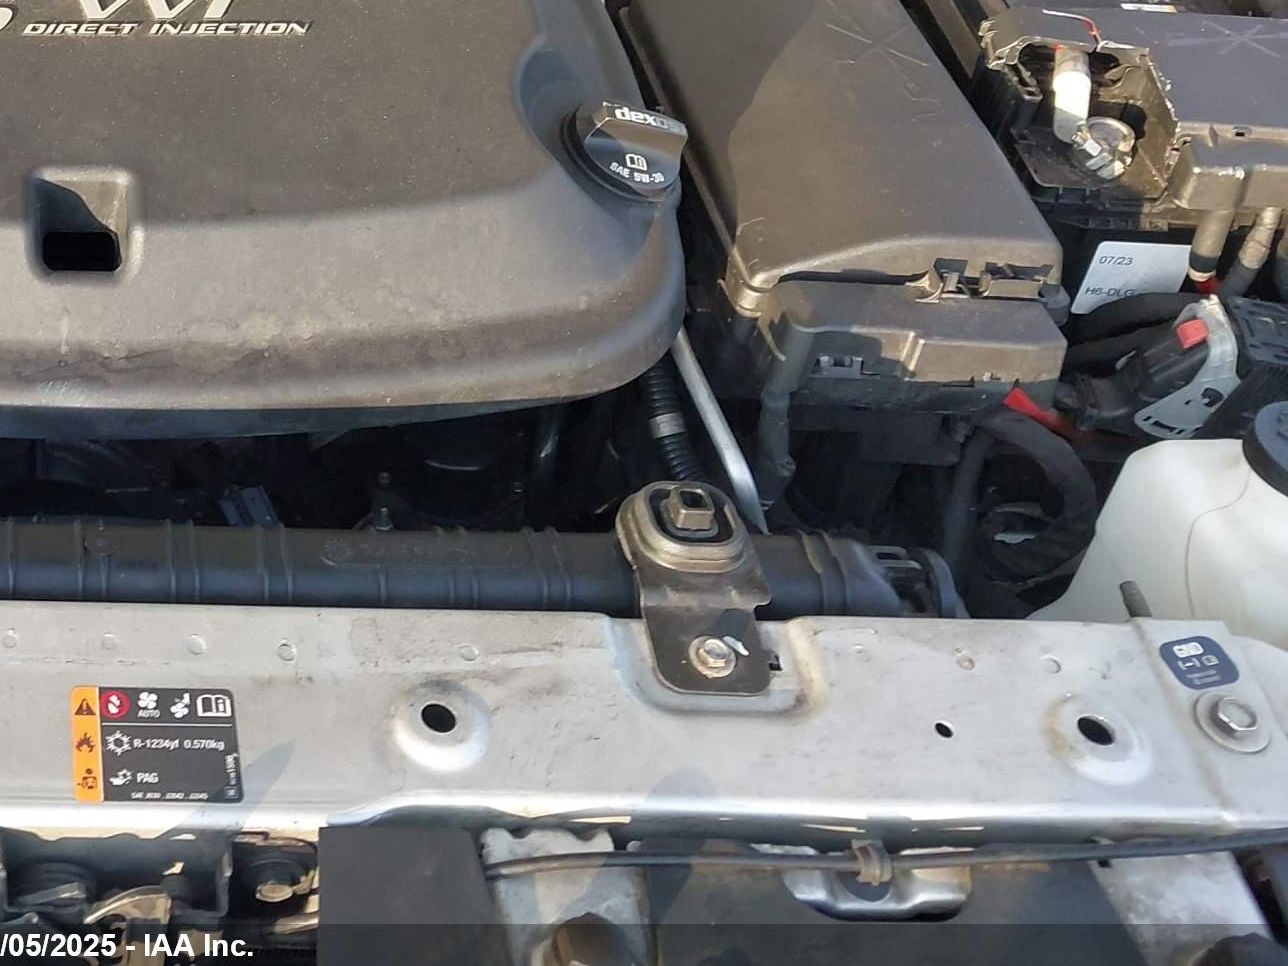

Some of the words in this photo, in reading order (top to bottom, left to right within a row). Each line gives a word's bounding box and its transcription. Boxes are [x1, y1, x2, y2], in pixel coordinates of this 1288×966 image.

[23, 23, 138, 36] DIRECT
[149, 22, 310, 36] INJECTION
[609, 162, 631, 178] SAE
[1099, 255, 1134, 266] 07/23
[137, 709, 161, 718] AUTO
[136, 772, 159, 783] PAG
